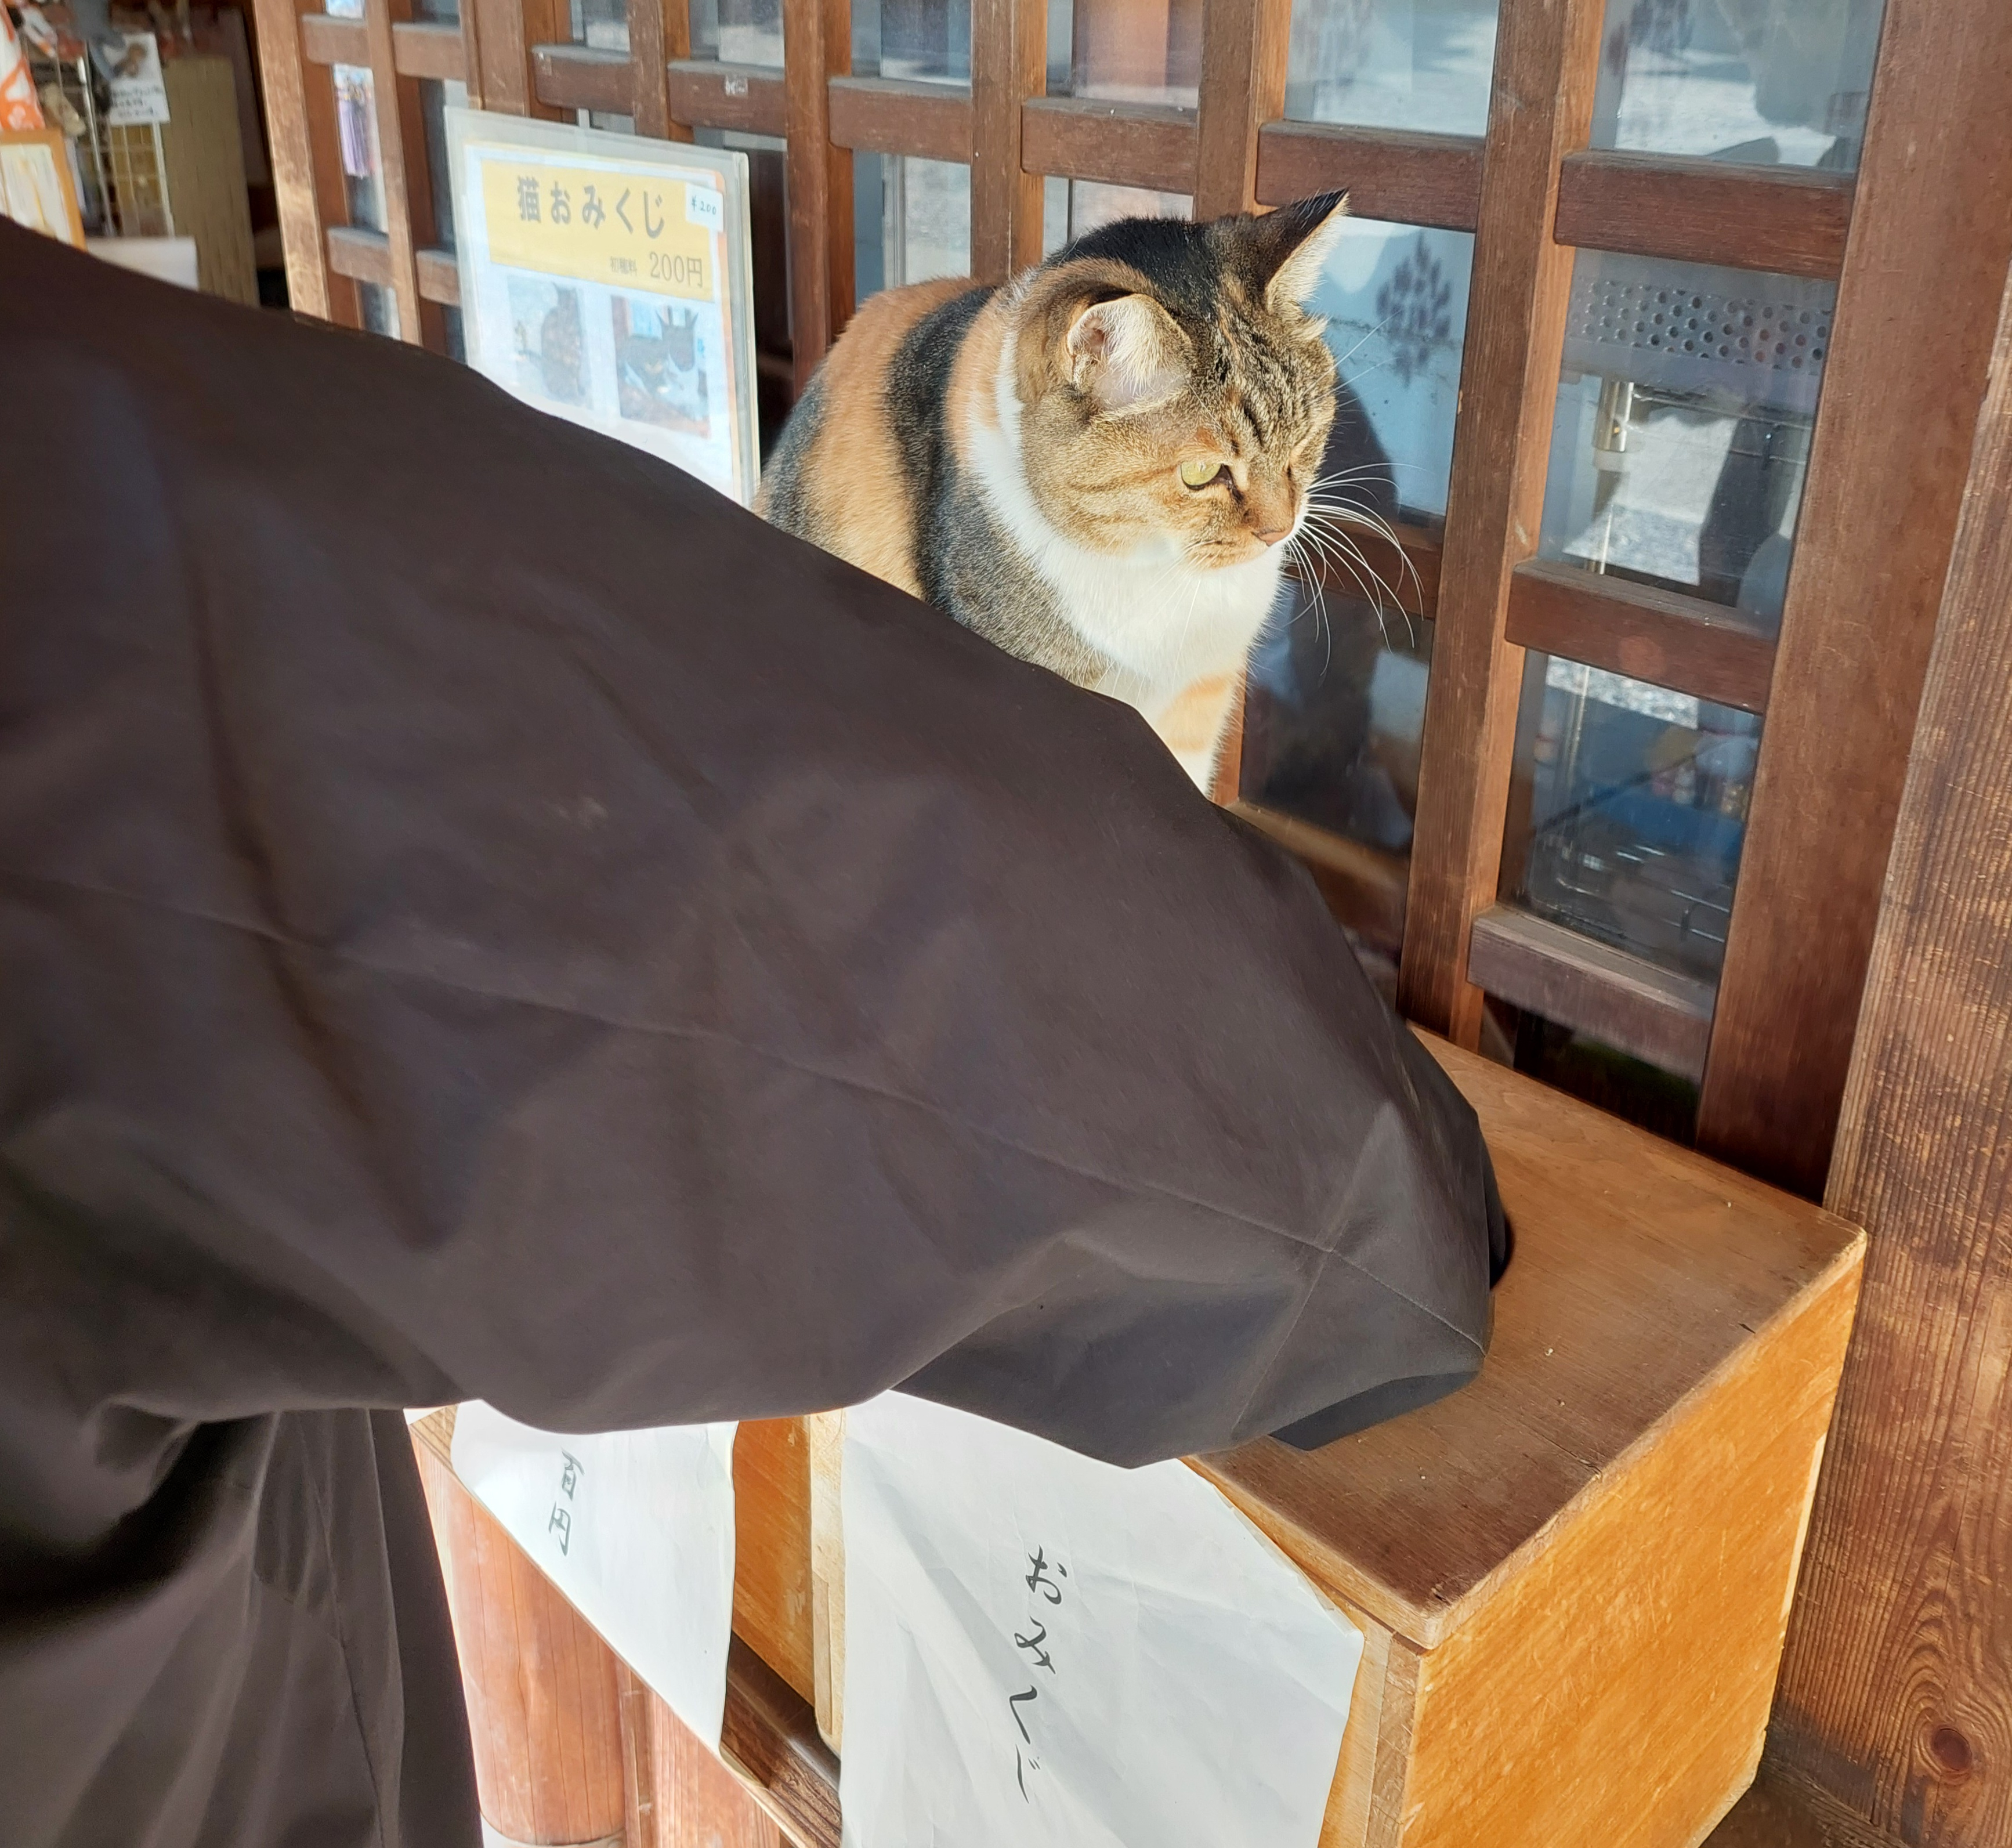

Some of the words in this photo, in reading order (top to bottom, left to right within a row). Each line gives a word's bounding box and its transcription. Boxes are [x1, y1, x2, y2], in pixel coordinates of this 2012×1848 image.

[517, 175, 665, 238] 猫おみくじ
[649, 251, 703, 288] 200円
[1009, 1544, 1067, 1804] おみくじ
